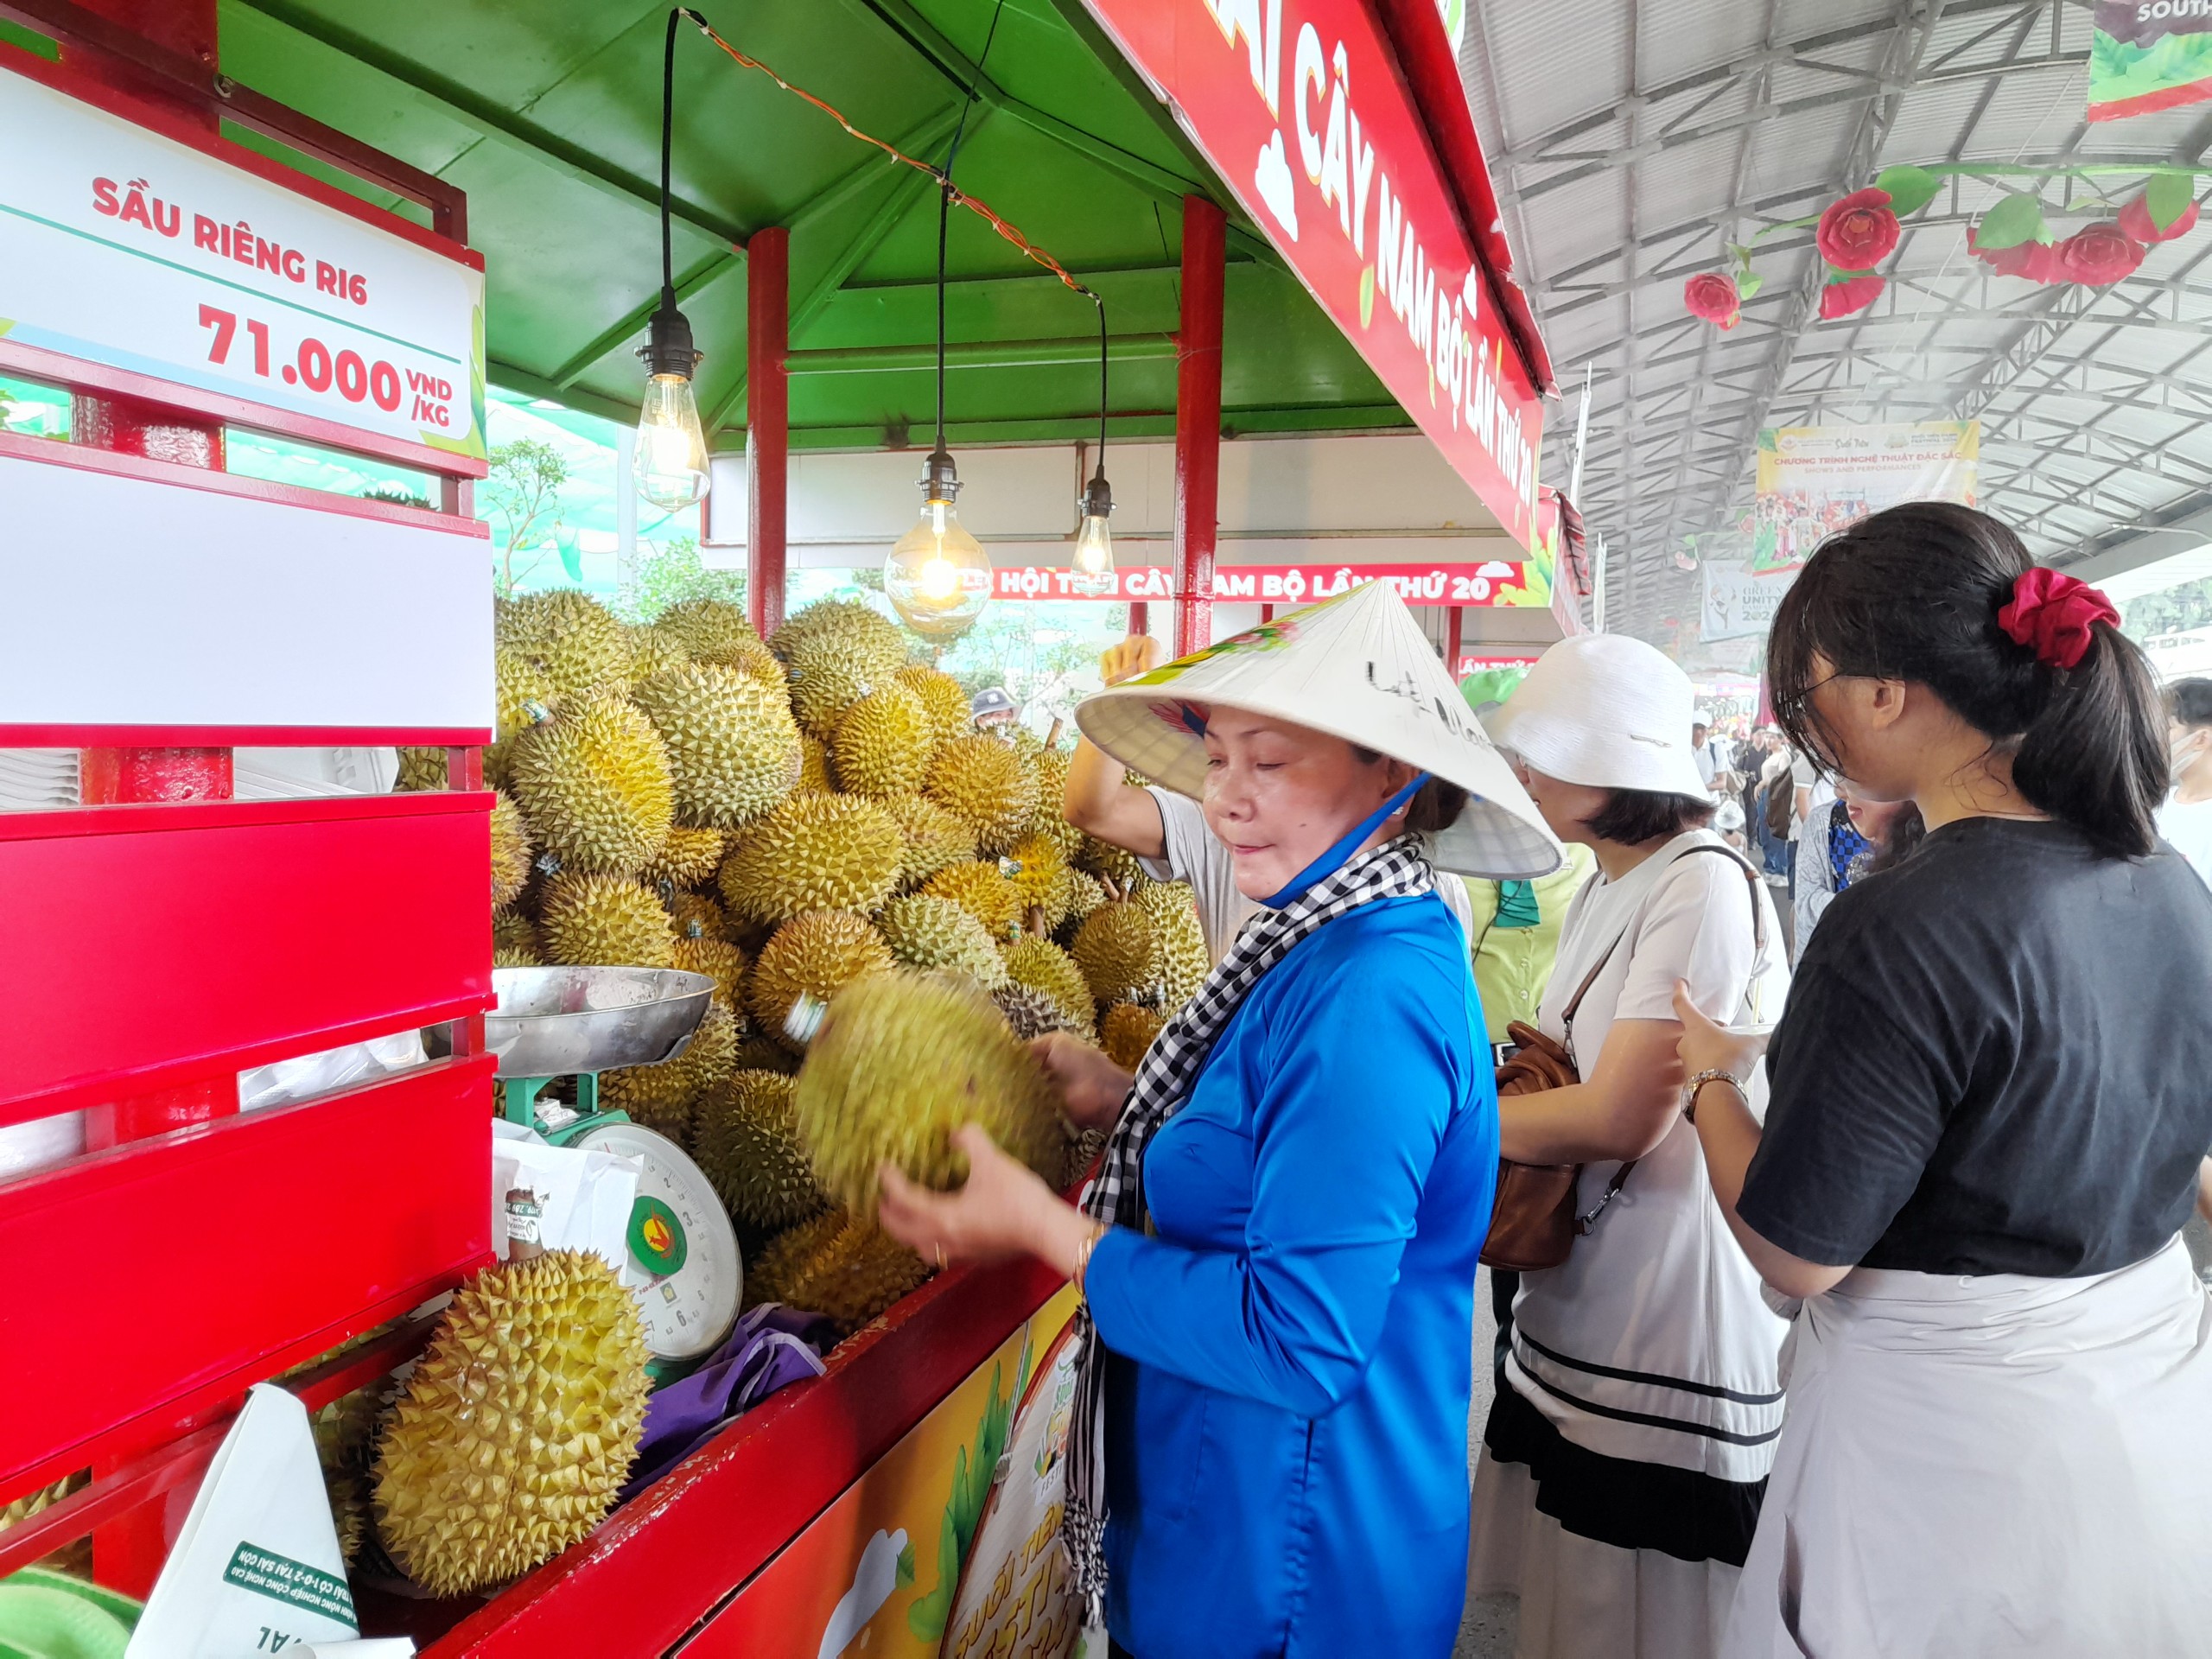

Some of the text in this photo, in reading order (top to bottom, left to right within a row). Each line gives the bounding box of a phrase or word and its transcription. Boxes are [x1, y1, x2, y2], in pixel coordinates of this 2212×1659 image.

[92, 177, 368, 305] SẦU RIÊNG RI6
[1294, 22, 1375, 261] CÂY
[1377, 172, 1434, 365] NAM
[1436, 288, 1462, 432] BỘ
[1465, 335, 1495, 458] LẦN
[1497, 394, 1521, 490] THỨ
[1519, 437, 1532, 507] 20
[199, 303, 453, 411] 71.000 VND
[411, 399, 450, 427] /KG
[1818, 454, 1847, 465] TRÌNH
[1851, 454, 1878, 464] NGHỆ
[1881, 452, 1914, 464] THUẬT
[1916, 451, 1940, 462] ĐẶC
[1941, 450, 1962, 461] SẮC
[1001, 567, 1049, 598] HỘI
[1055, 572, 1118, 595] TI
[1214, 575, 1255, 596] AM
[1262, 569, 1306, 602] BỘ
[1385, 570, 1448, 598] THỨ
[1452, 577, 1491, 601] 20
[1742, 595, 1782, 605] UNITY
[1742, 611, 1770, 621] 202
[238, 1549, 257, 1567] GÒN
[256, 1556, 276, 1573] SÀI
[231, 1566, 245, 1579] CAO
[244, 1568, 267, 1586] NGHỆ
[275, 1560, 295, 1580] TẠI
[265, 1579, 290, 1595] CÔNG
[294, 1572, 321, 1589] 1-0-2
[319, 1581, 334, 1597] CÓ
[289, 1586, 321, 1608] NGHIỆP
[320, 1598, 342, 1614] NÔNG
[257, 1626, 302, 1654] AL
